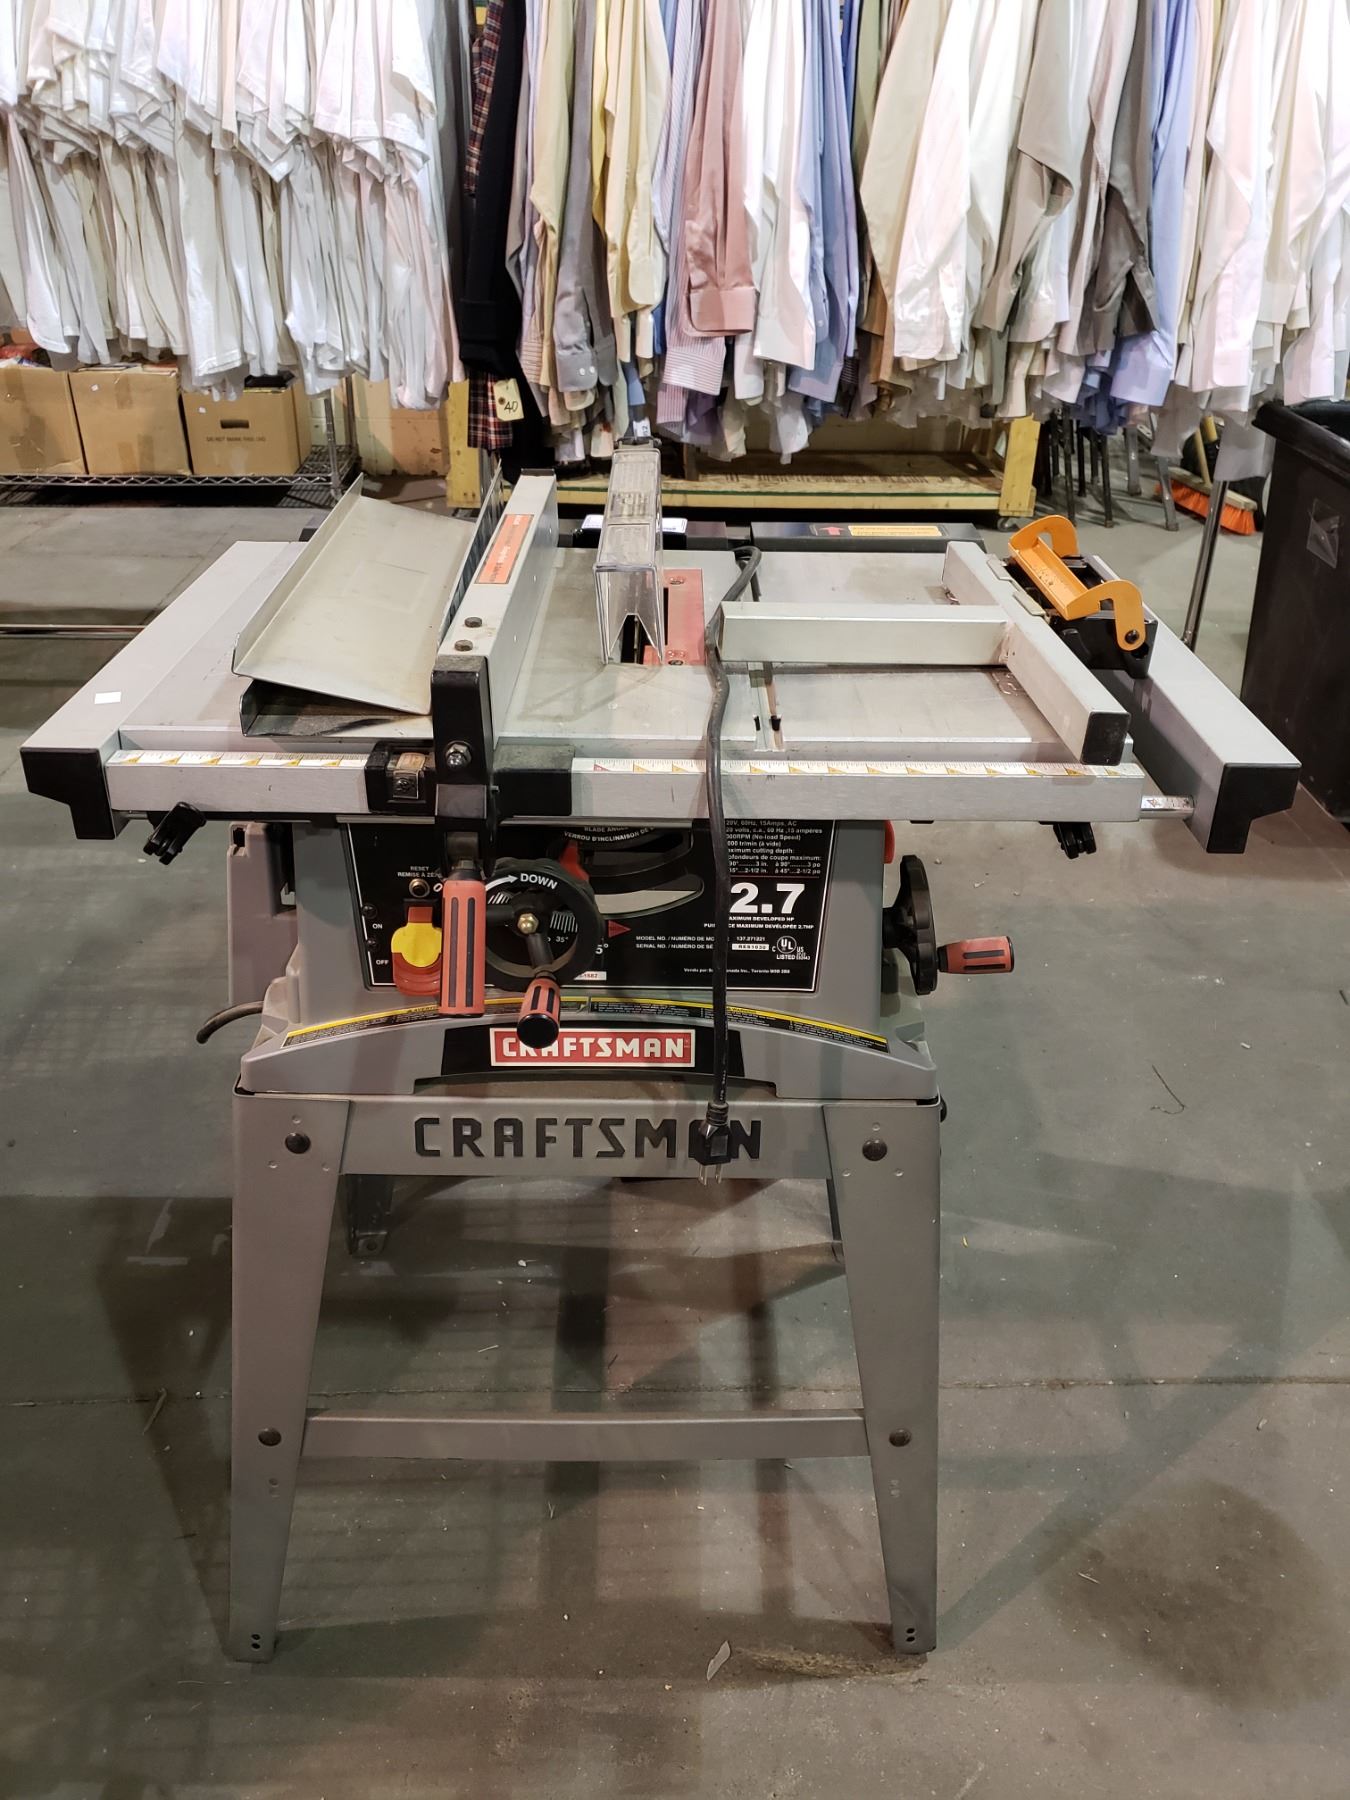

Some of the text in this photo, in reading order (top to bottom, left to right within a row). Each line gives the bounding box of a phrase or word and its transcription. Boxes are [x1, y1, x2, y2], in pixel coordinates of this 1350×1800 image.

[519, 873, 558, 890] DOWN
[729, 882, 805, 914] 2.7
[780, 938, 794, 950] UL
